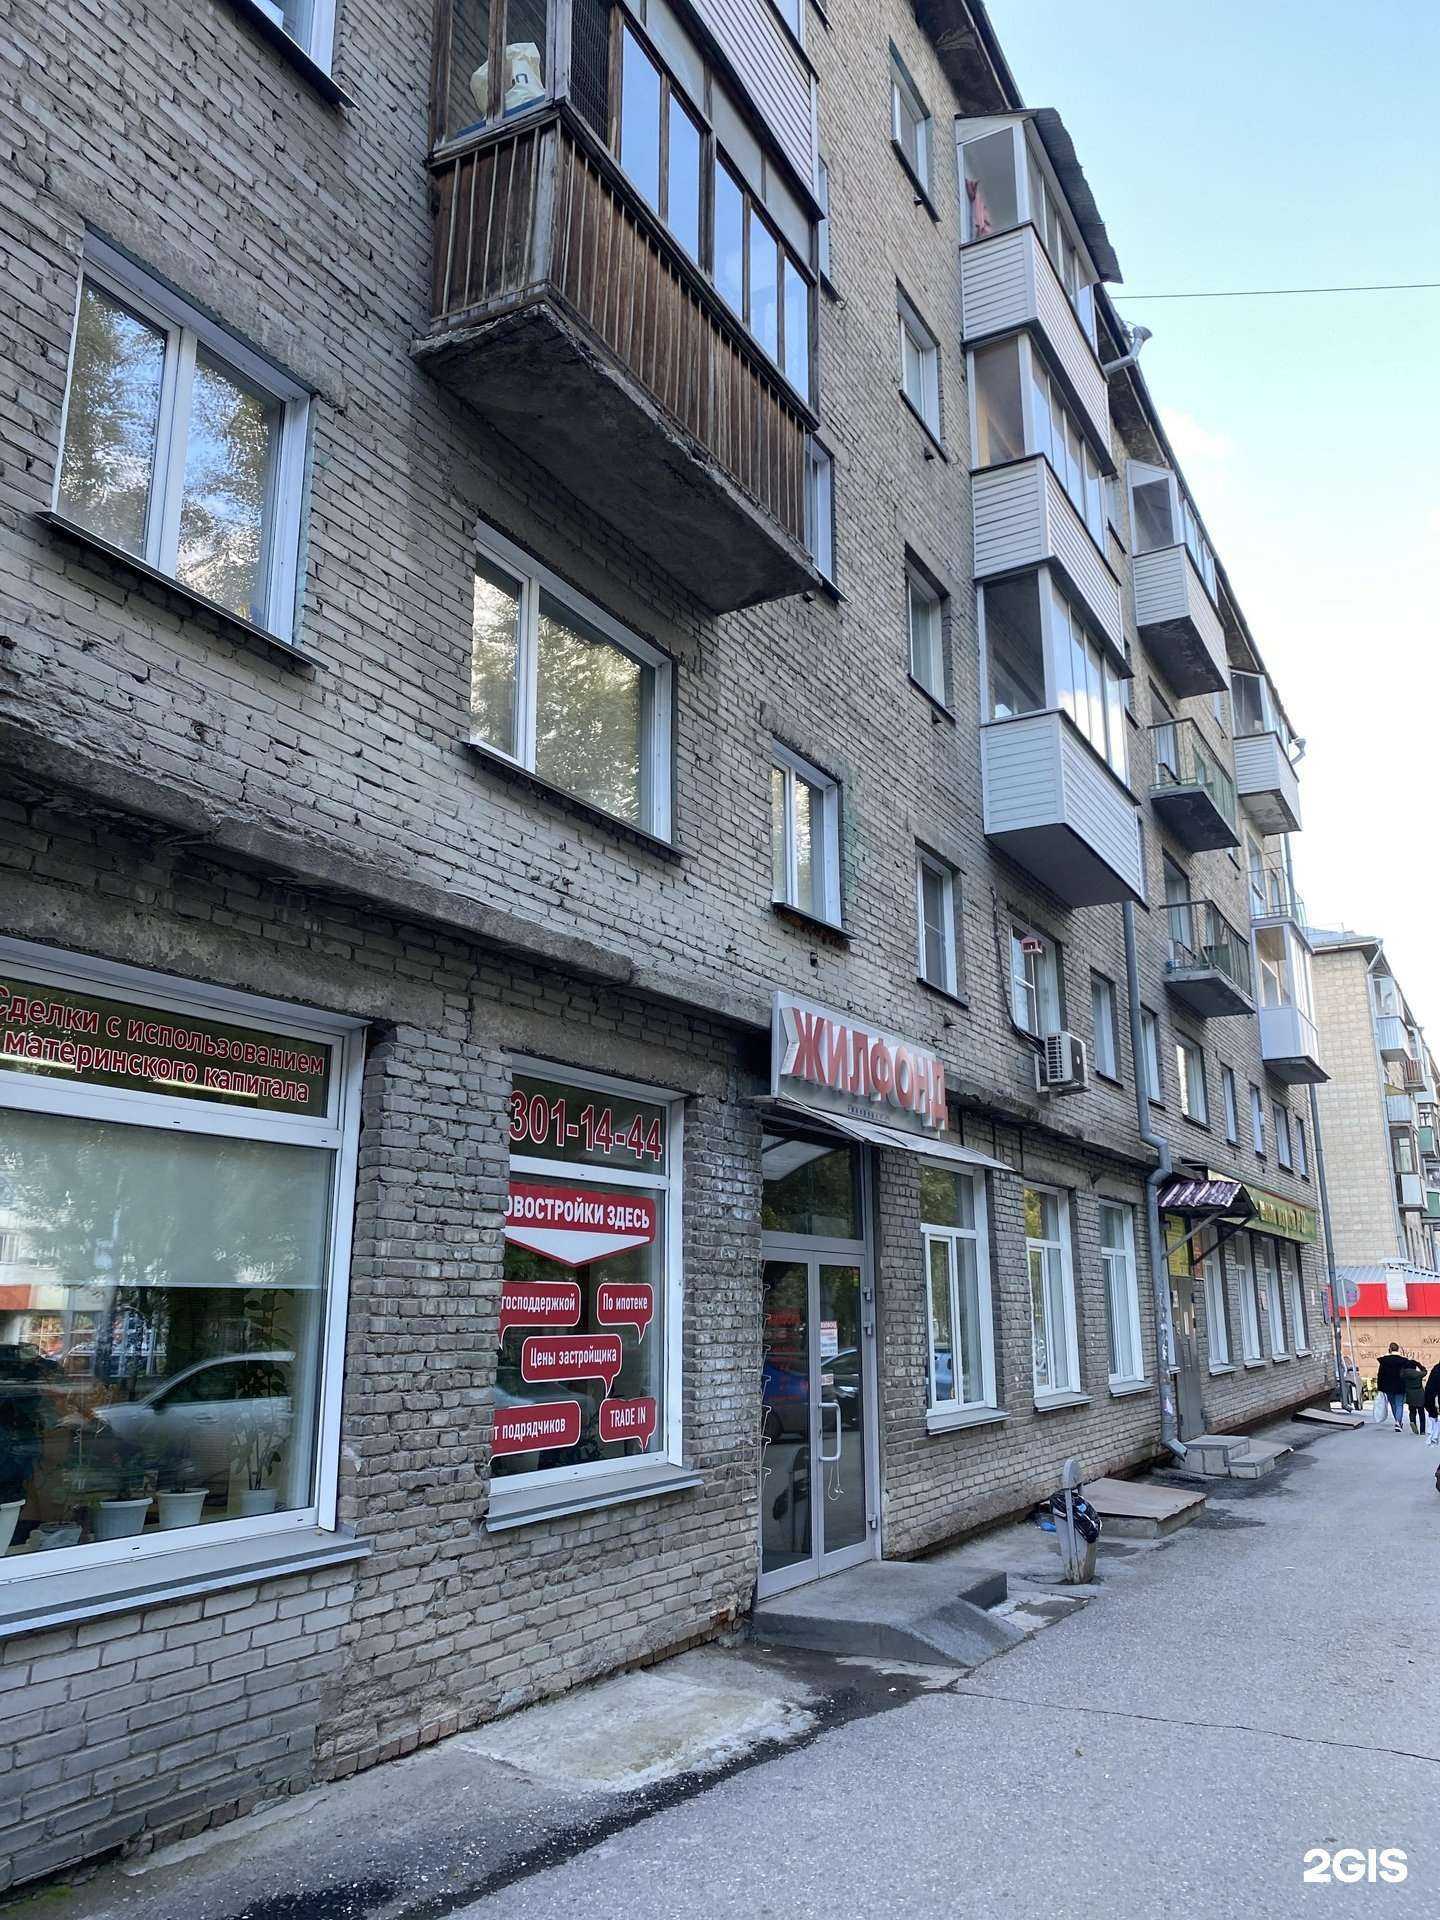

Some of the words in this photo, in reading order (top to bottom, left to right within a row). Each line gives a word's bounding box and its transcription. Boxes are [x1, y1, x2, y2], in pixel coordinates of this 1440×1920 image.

[106, 1015, 121, 1038] с
[127, 1016, 325, 1077] использованием
[3, 1030, 198, 1084] материнского
[203, 1065, 309, 1103] капитала
[783, 1007, 948, 1131] ЖИЛФОНД
[509, 1090, 663, 1162] 301-14-44
[607, 1204, 650, 1231] ЗДЕСЬ
[501, 1294, 576, 1315] господдержкой
[603, 1293, 613, 1311] По
[615, 1295, 648, 1310] ипотеке
[530, 1347, 556, 1369] Цены
[558, 1345, 617, 1369] застройщика
[502, 1418, 566, 1443] подрядчиков
[609, 1407, 635, 1429] TRADE
[637, 1406, 646, 1425] IN
